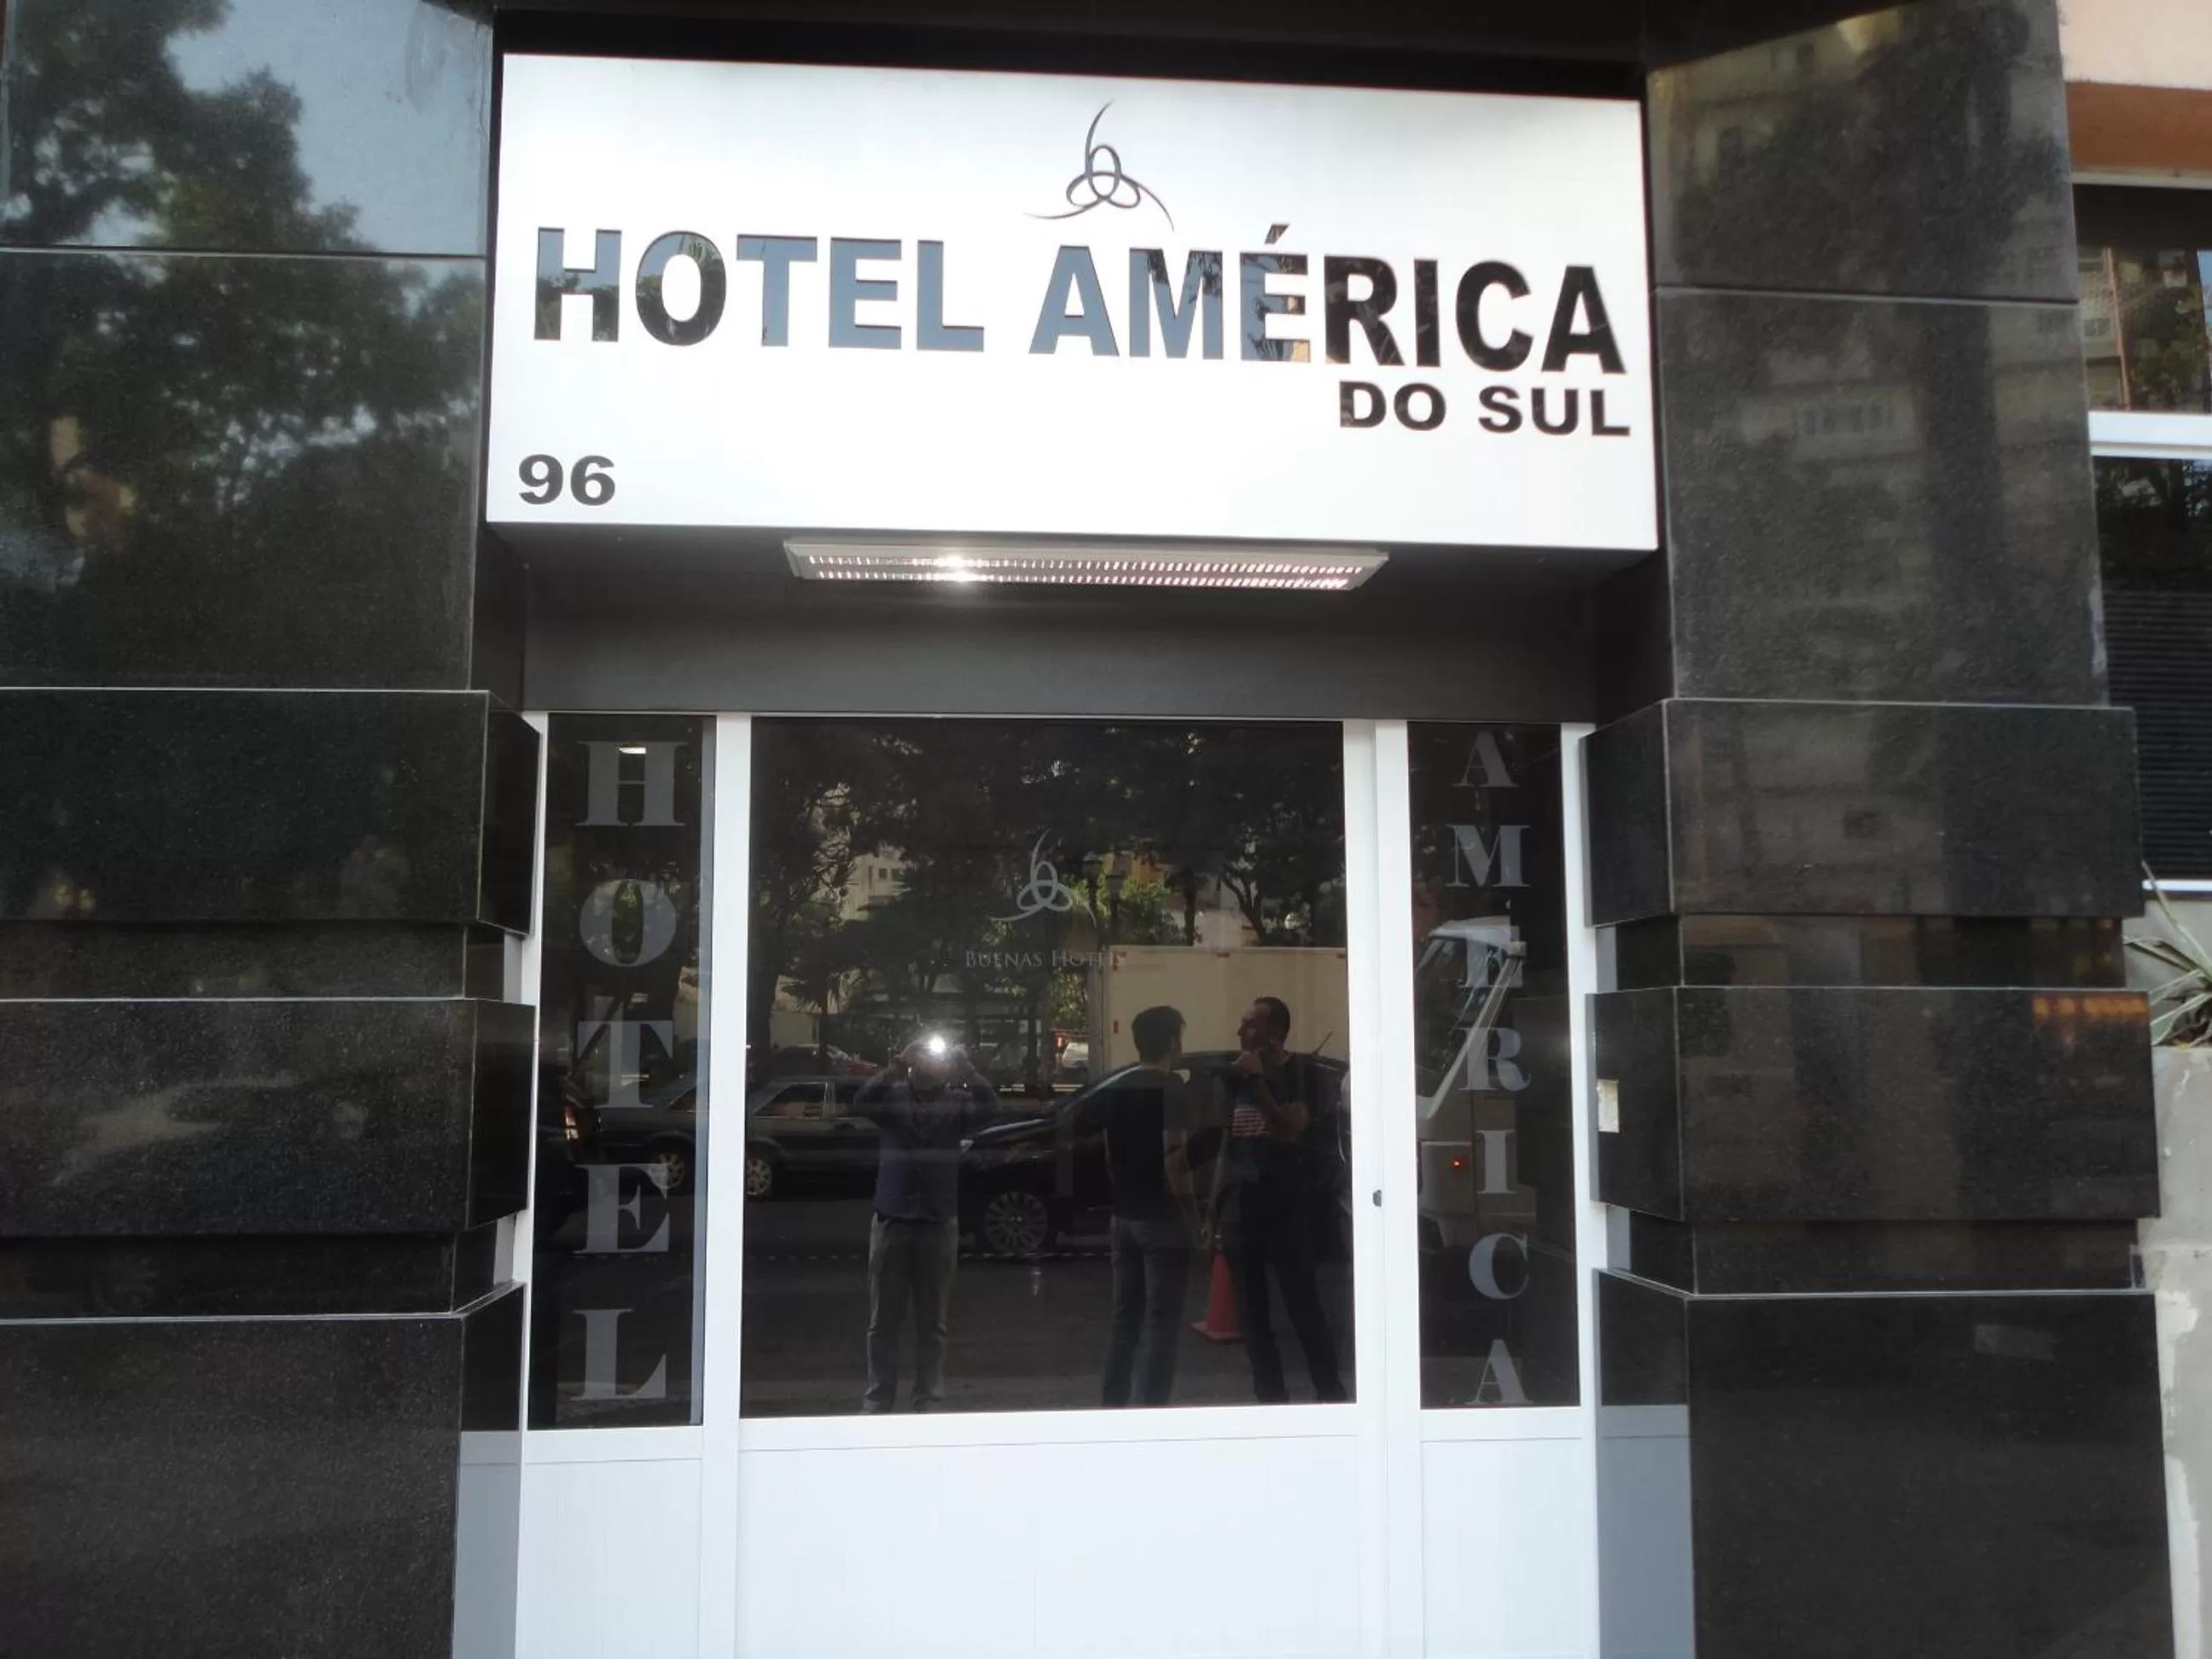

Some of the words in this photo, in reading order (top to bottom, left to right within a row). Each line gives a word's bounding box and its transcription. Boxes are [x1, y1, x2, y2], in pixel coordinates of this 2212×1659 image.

[534, 226, 985, 352] HOTEL
[1028, 223, 1628, 375] AMÉRICA
[1338, 381, 1447, 432] DO
[1477, 385, 1631, 437] SUL
[517, 453, 616, 506] 96
[965, 949, 1042, 968] BUENAS
[572, 741, 688, 1400] HOTEL
